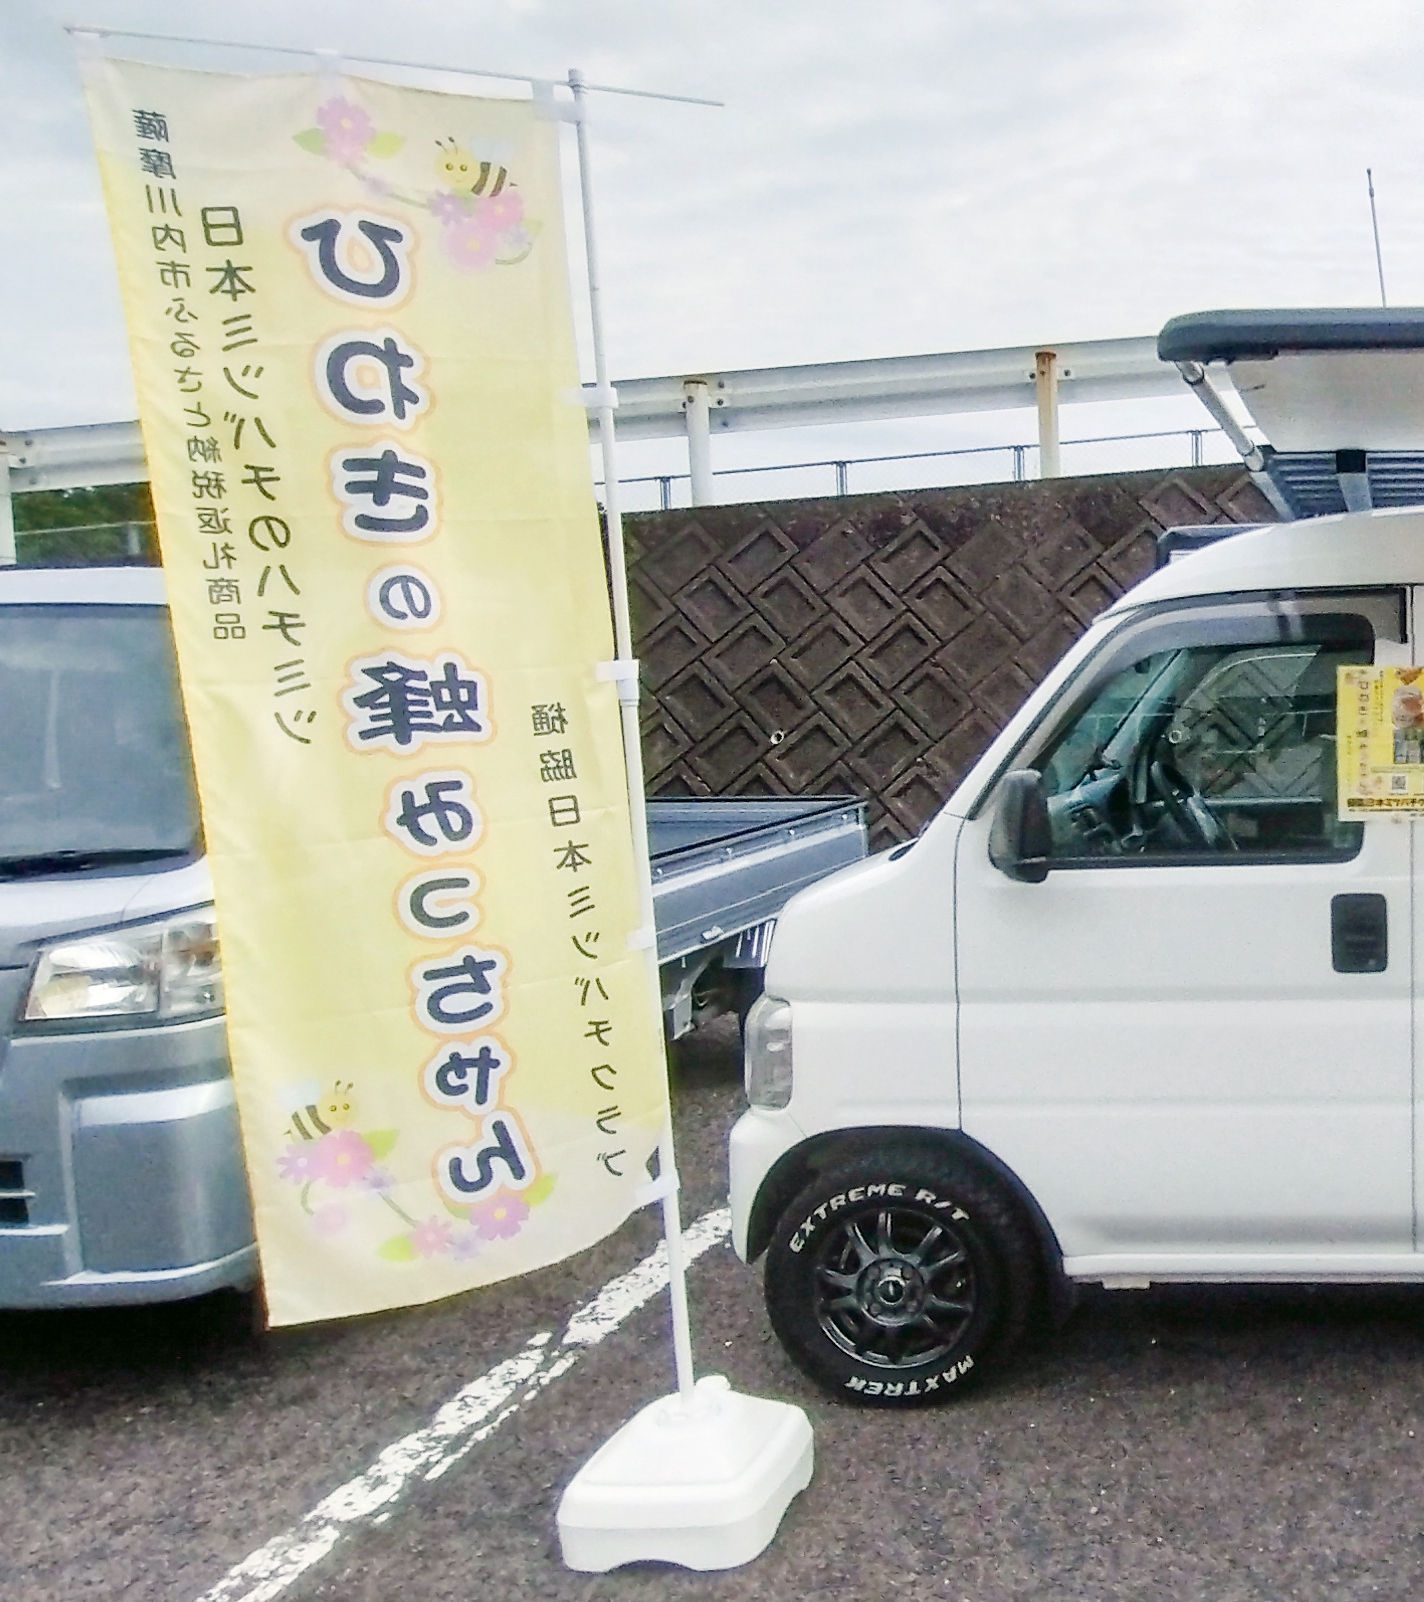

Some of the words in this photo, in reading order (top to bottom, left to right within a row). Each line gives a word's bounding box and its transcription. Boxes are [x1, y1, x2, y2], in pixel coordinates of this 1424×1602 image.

[789, 1183, 906, 1253] EXTREME
[915, 1188, 970, 1222] R/T
[844, 1354, 975, 1397] MAXTREK
